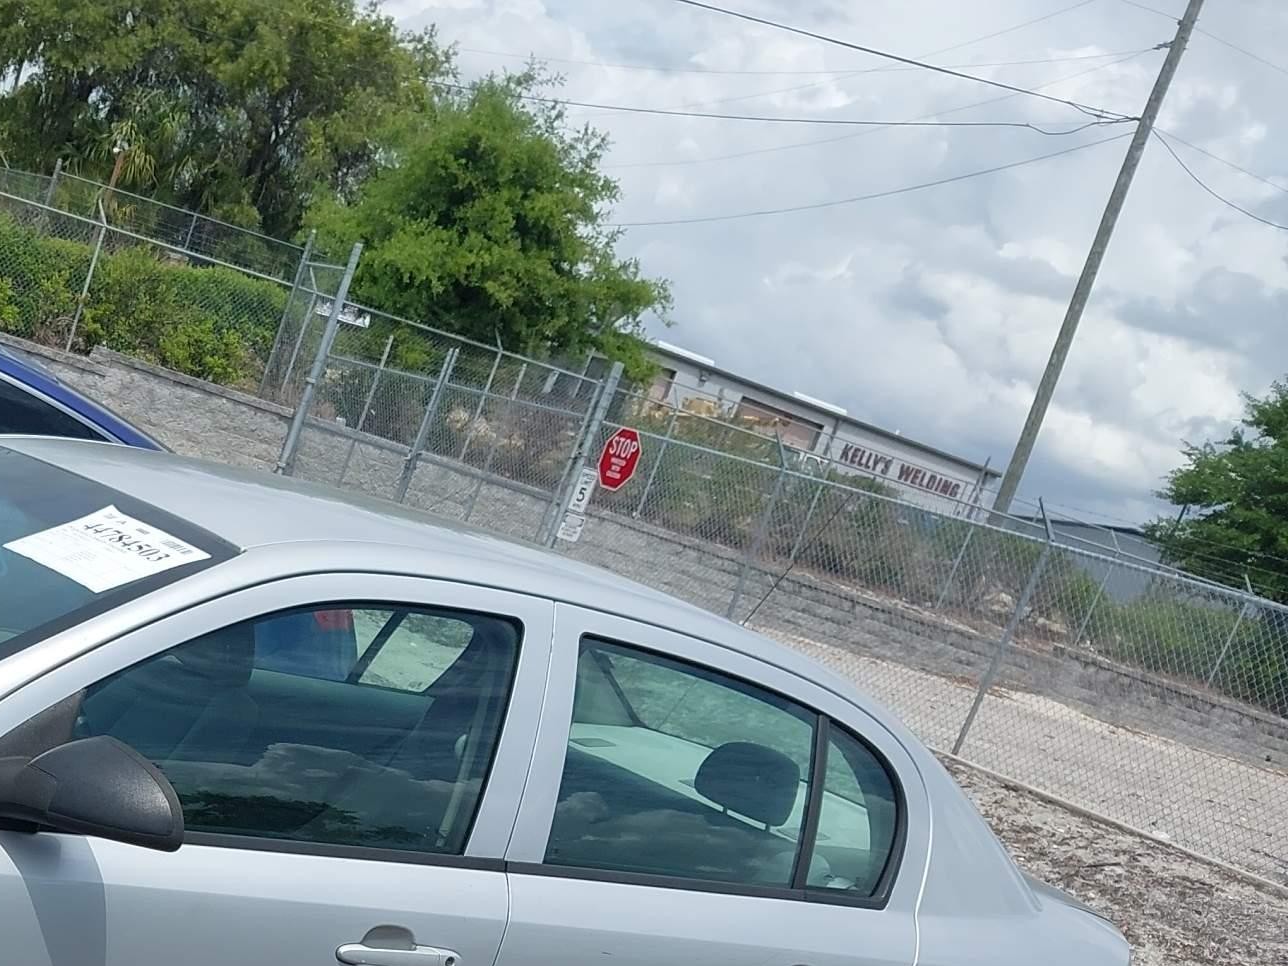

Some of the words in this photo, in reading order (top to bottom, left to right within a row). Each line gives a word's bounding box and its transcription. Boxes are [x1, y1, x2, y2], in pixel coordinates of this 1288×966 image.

[609, 436, 638, 459] STOP
[840, 443, 894, 475] KELLY'S
[897, 463, 961, 498] WELDING
[576, 487, 587, 502] 5
[84, 524, 170, 561] 44784503
